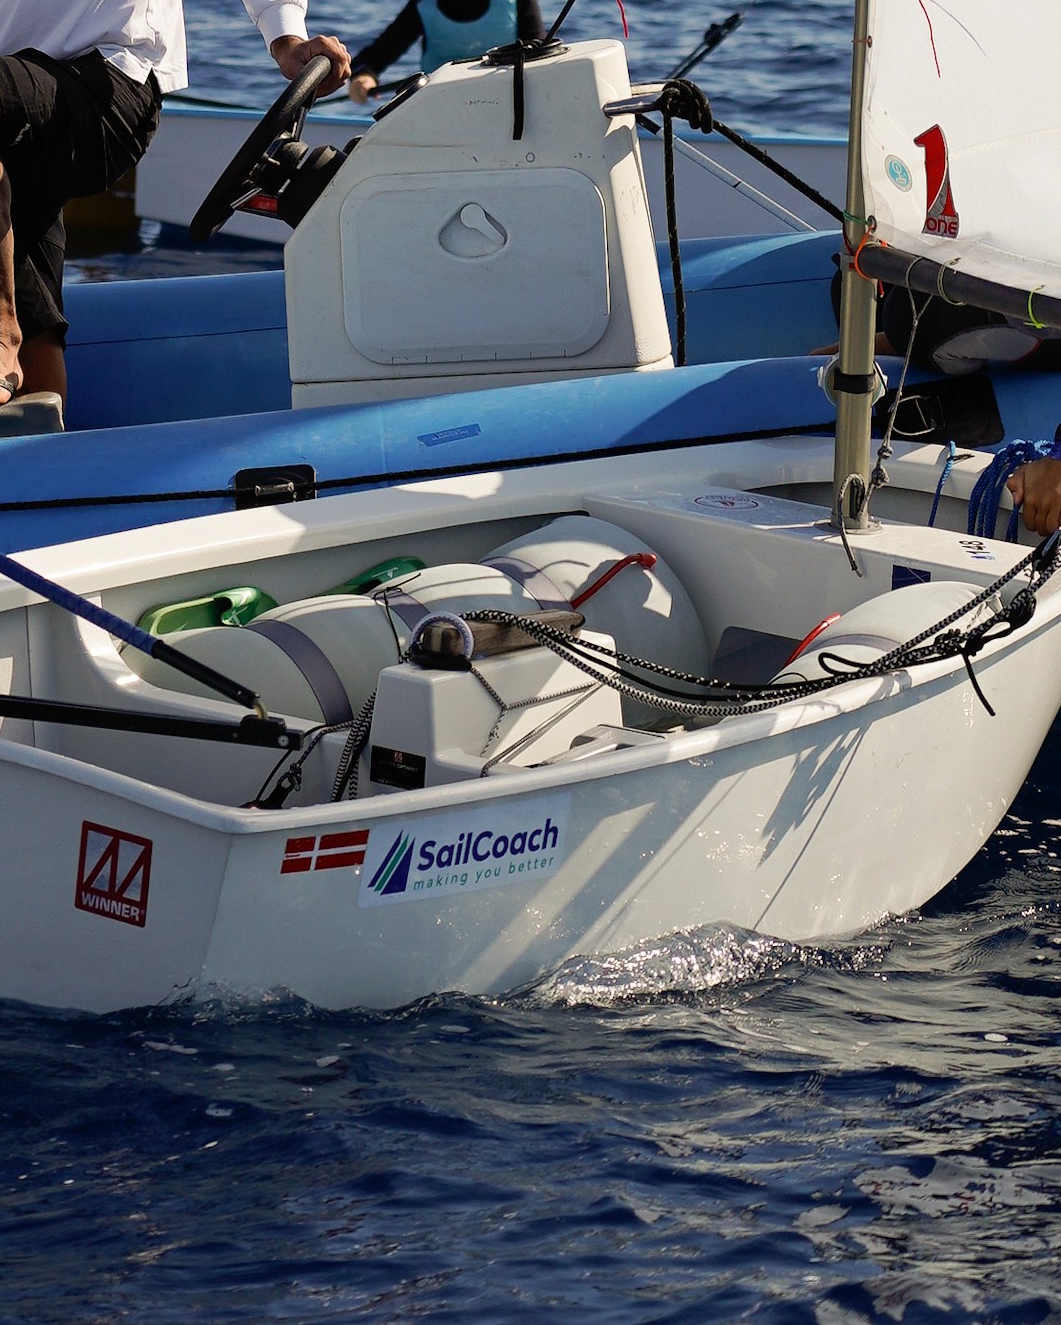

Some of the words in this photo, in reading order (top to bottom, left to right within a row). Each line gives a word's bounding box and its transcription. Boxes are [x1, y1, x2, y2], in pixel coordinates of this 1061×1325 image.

[417, 818, 559, 871] SailCoach
[413, 873, 469, 890] making
[475, 866, 501, 883] you
[509, 856, 555, 874] better
[81, 891, 141, 922] WINNER
